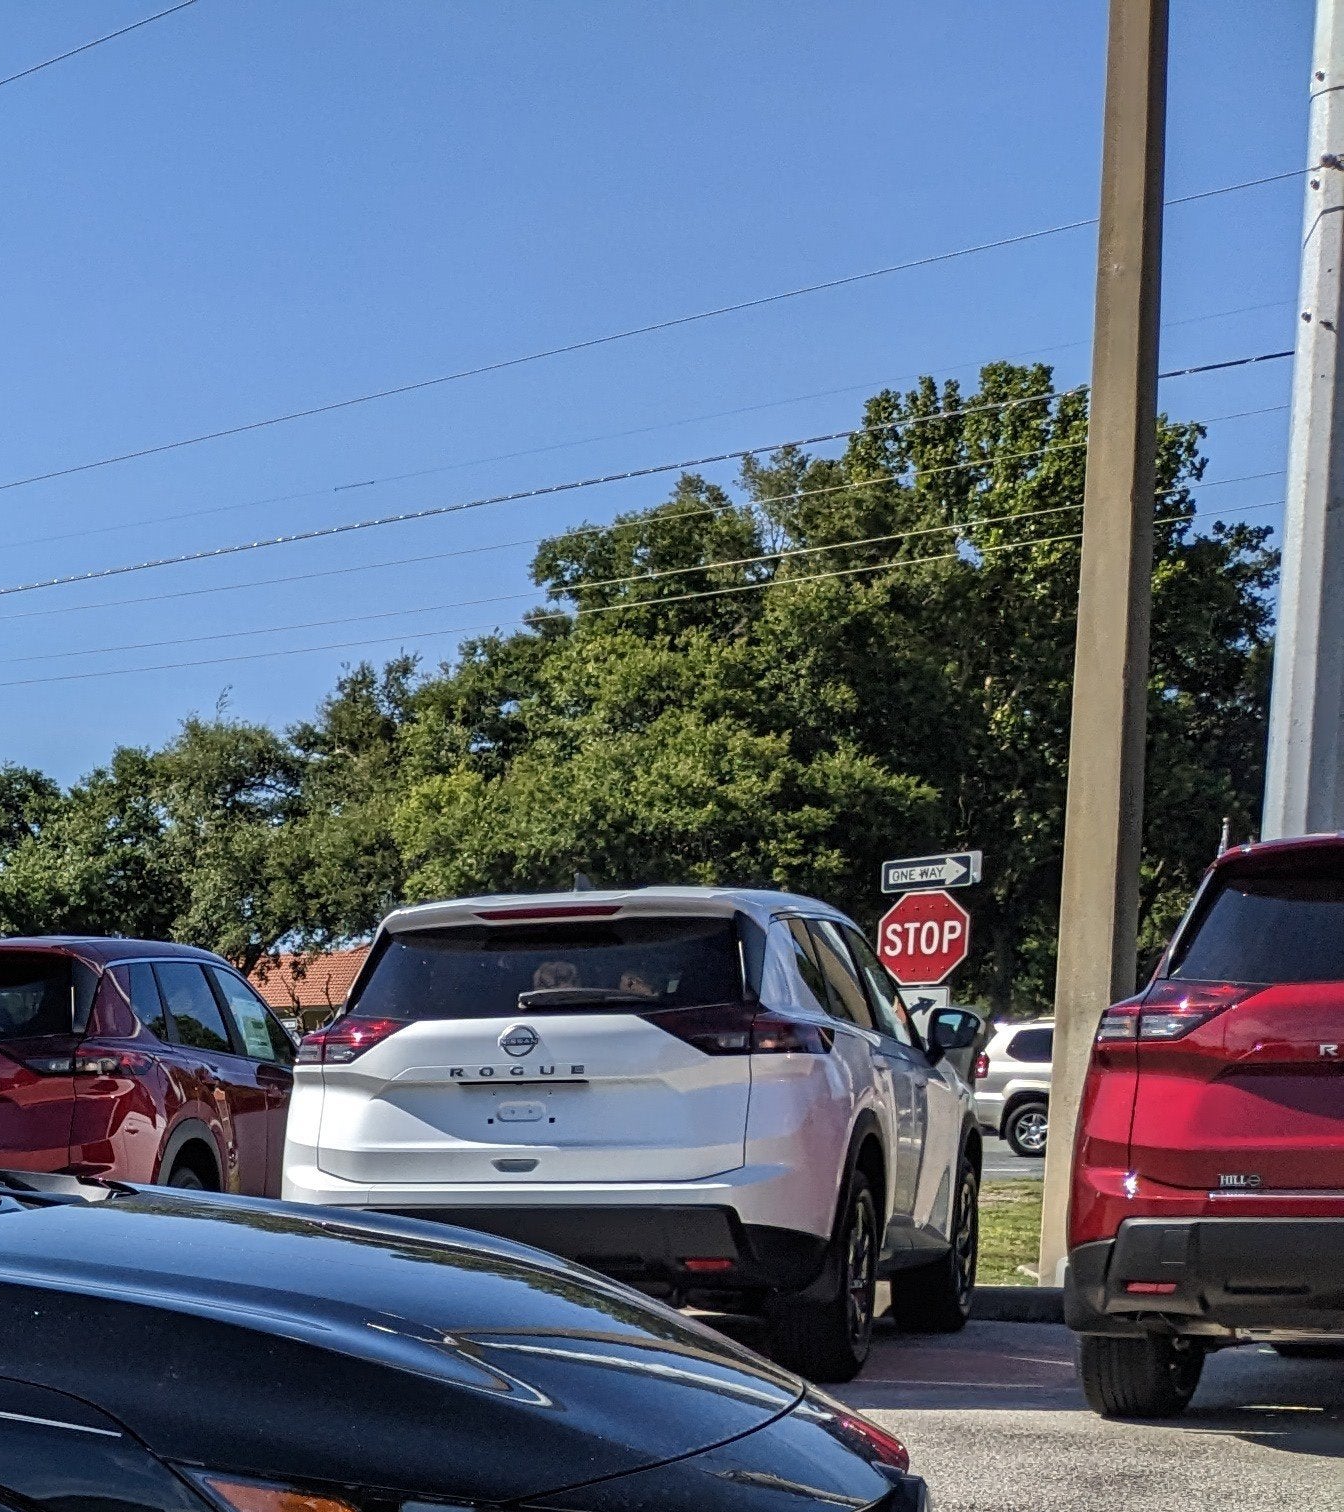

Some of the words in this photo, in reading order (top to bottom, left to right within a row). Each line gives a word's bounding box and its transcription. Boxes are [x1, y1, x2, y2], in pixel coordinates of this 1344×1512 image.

[892, 868, 916, 882] ONE
[919, 866, 944, 880] WAY
[883, 920, 962, 957] STOP
[449, 1065, 585, 1077] ROGUE
